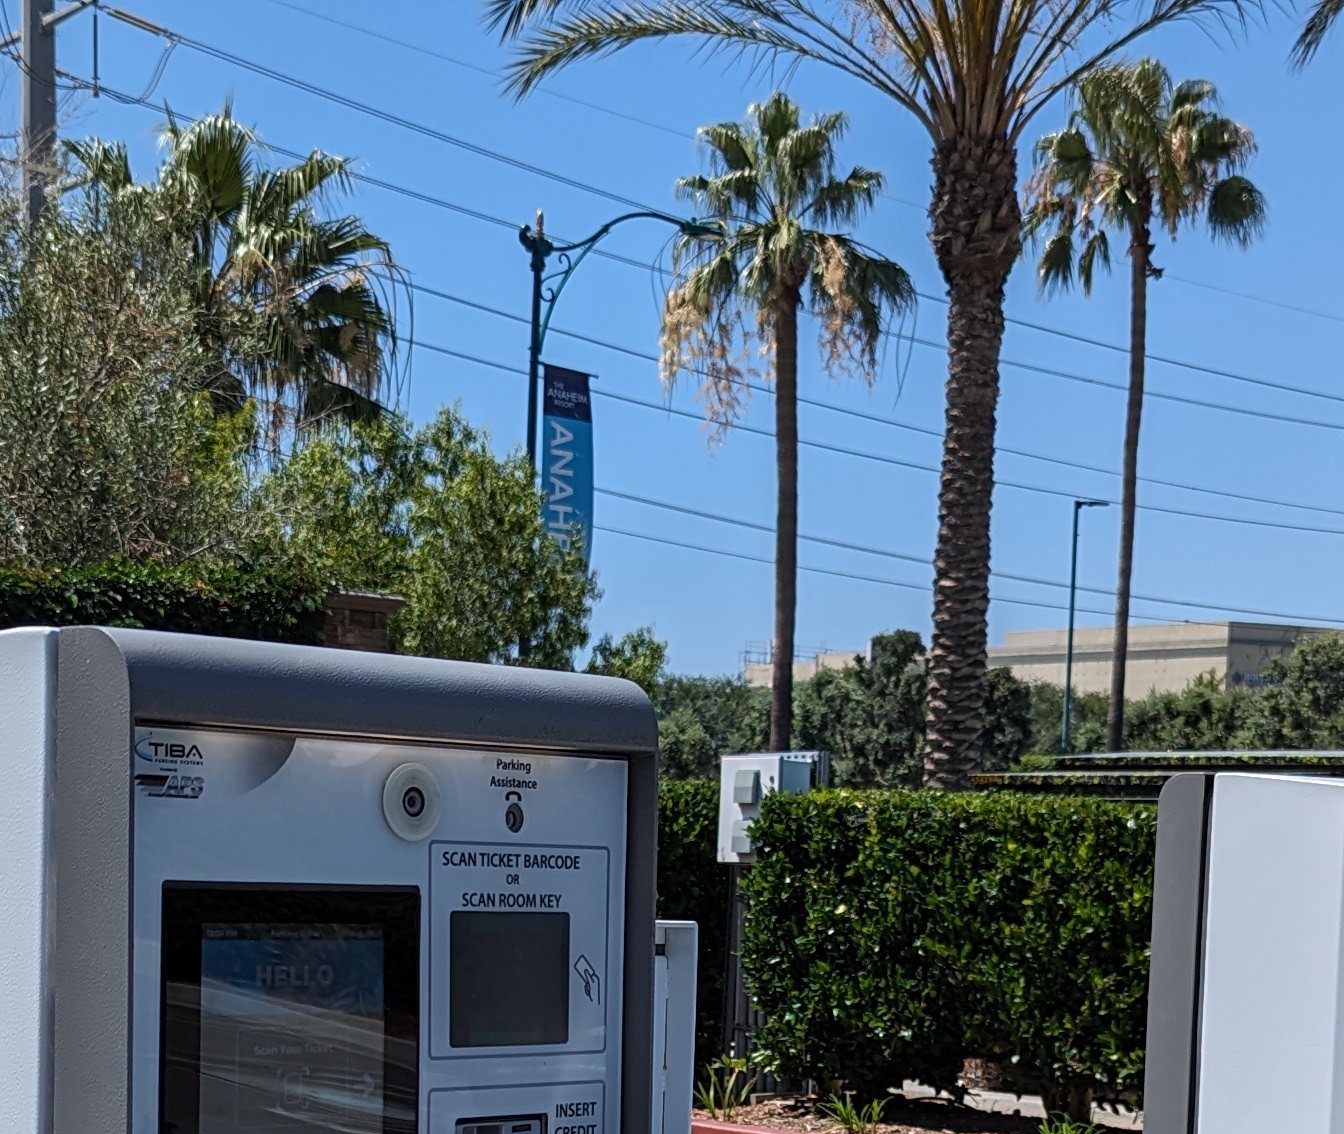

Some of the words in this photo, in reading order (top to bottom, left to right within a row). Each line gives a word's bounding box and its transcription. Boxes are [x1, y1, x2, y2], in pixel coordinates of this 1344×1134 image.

[148, 742, 203, 759] TIBA
[496, 758, 532, 774] Parking
[490, 775, 537, 789] Assistance
[442, 851, 477, 867] SCAN
[479, 852, 521, 868] TICKET
[523, 854, 581, 870] BARCODE
[505, 874, 520, 885] OR
[461, 892, 496, 908] SCAN
[498, 893, 537, 908] ROOM
[539, 894, 562, 909] KEY
[256, 964, 334, 987] HELLO
[555, 1101, 597, 1119] INSERT
